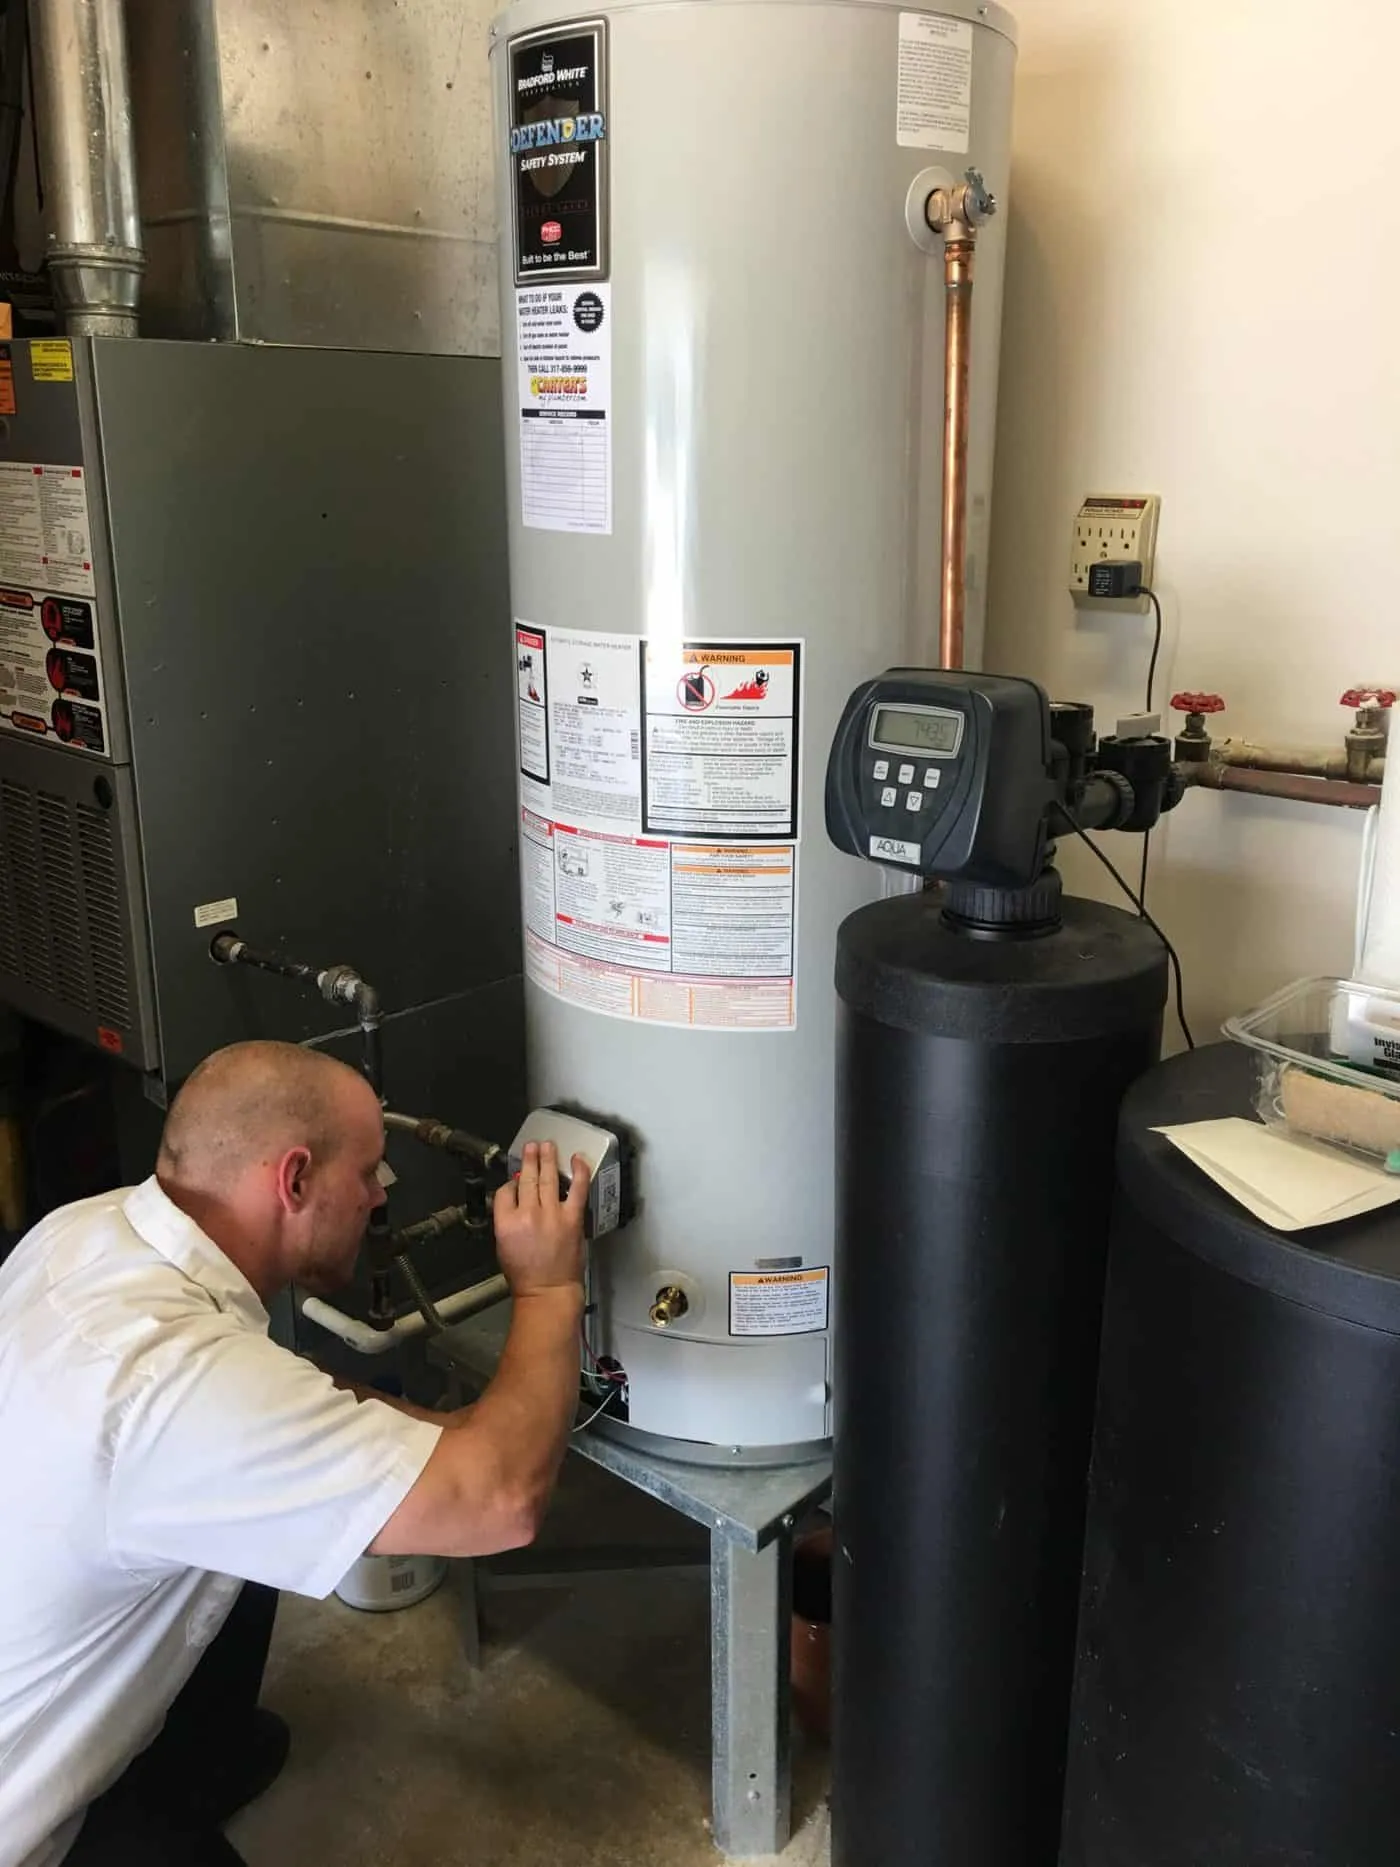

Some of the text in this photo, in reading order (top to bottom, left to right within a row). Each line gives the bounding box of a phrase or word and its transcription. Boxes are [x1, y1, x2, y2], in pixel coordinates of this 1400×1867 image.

[518, 67, 587, 91] BRADFORD WHITE
[511, 113, 605, 151] DEFENDER
[520, 152, 585, 171] SAFETY SYSTEM
[567, 250, 588, 260] Best
[701, 653, 746, 663] WARNING
[876, 840, 907, 856] AQUA
[764, 1274, 802, 1284] WARNING
